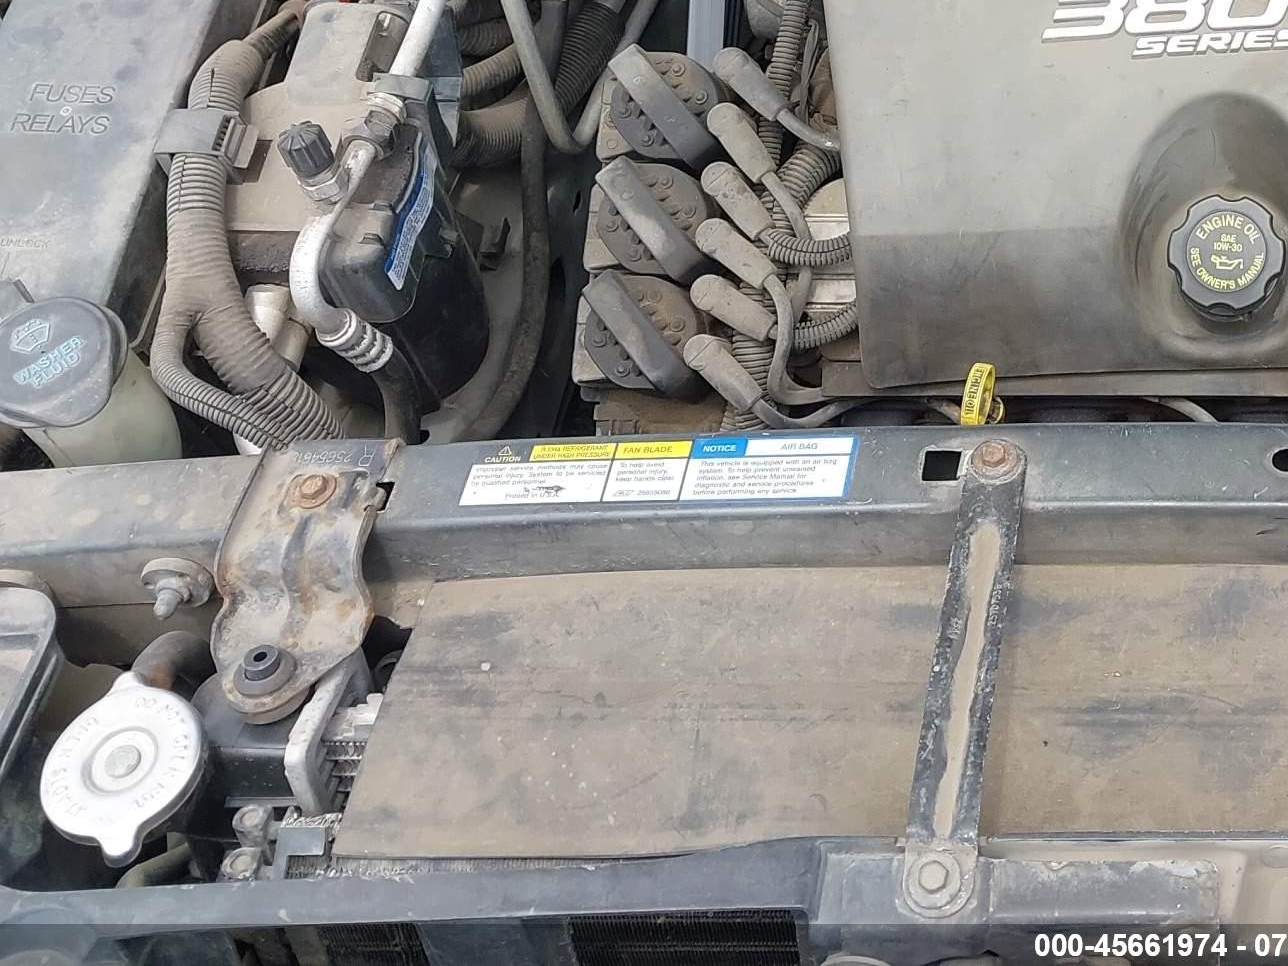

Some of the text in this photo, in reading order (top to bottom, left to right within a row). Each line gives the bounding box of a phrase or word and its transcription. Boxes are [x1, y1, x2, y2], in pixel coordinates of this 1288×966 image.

[29, 82, 117, 104] FUSES
[10, 112, 111, 135] RELAYS
[1195, 214, 1260, 245] ENGINE OIL
[1220, 233, 1237, 243] SAE
[1213, 242, 1243, 252] 10W-30
[1190, 247, 1265, 290] SEE OWNER'S MANUAL
[13, 335, 87, 386] WASHER
[30, 353, 82, 389] FLUID
[643, 445, 673, 453] BLADE
[703, 444, 737, 452] NOTICE
[780, 442, 819, 451] AIR BAG
